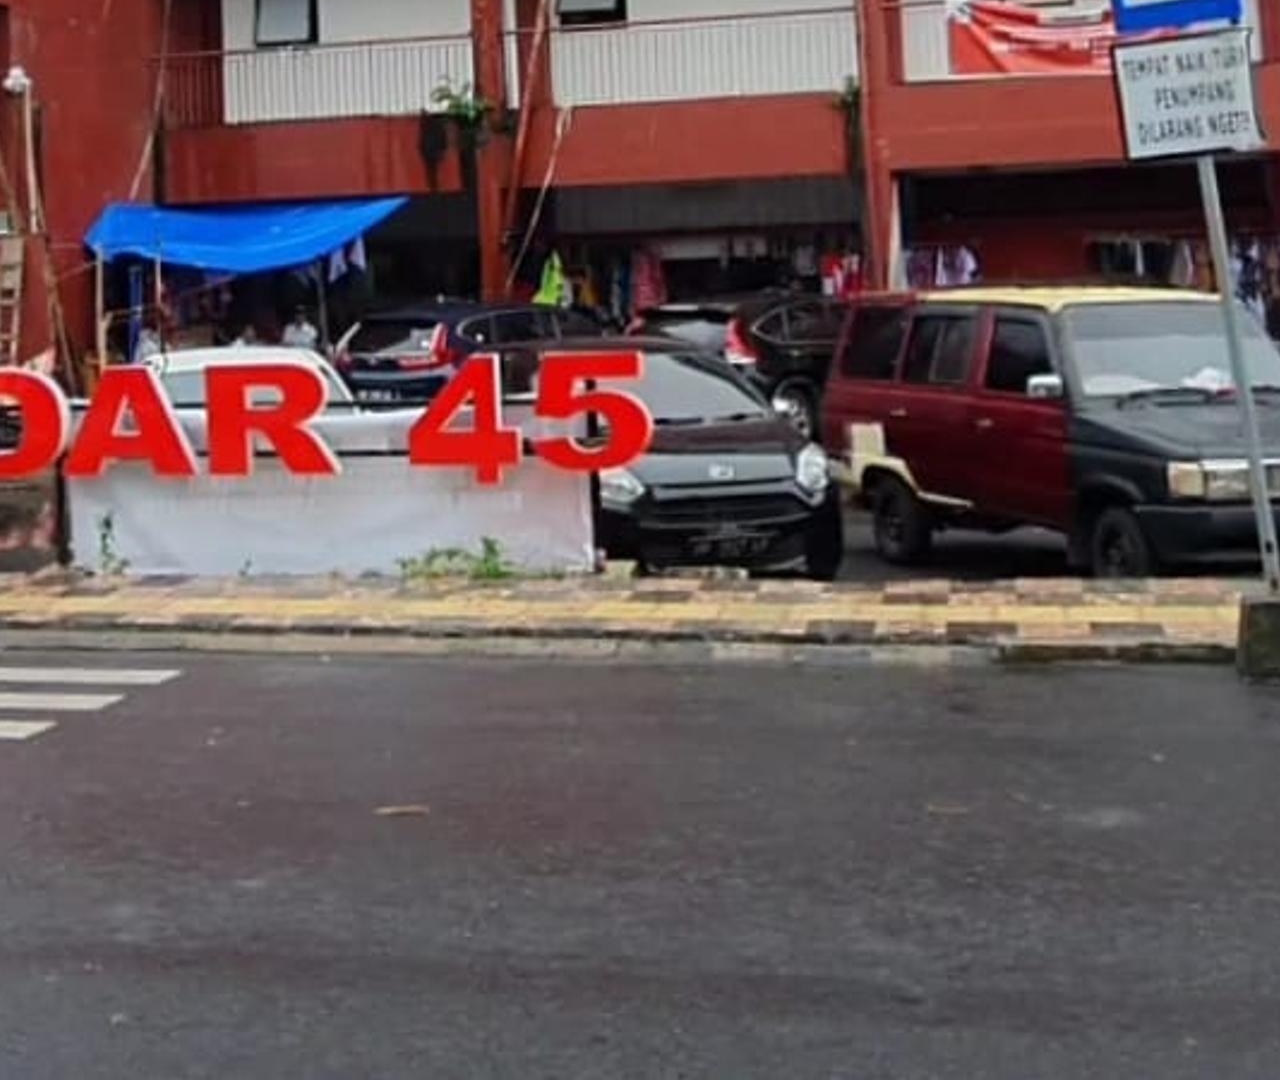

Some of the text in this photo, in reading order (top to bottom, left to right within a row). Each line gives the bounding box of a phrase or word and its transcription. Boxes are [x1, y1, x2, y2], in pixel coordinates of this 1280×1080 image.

[1155, 82, 1236, 110] PENUMPANG
[1139, 115, 1202, 146] DILARANG
[408, 349, 656, 485] 45
